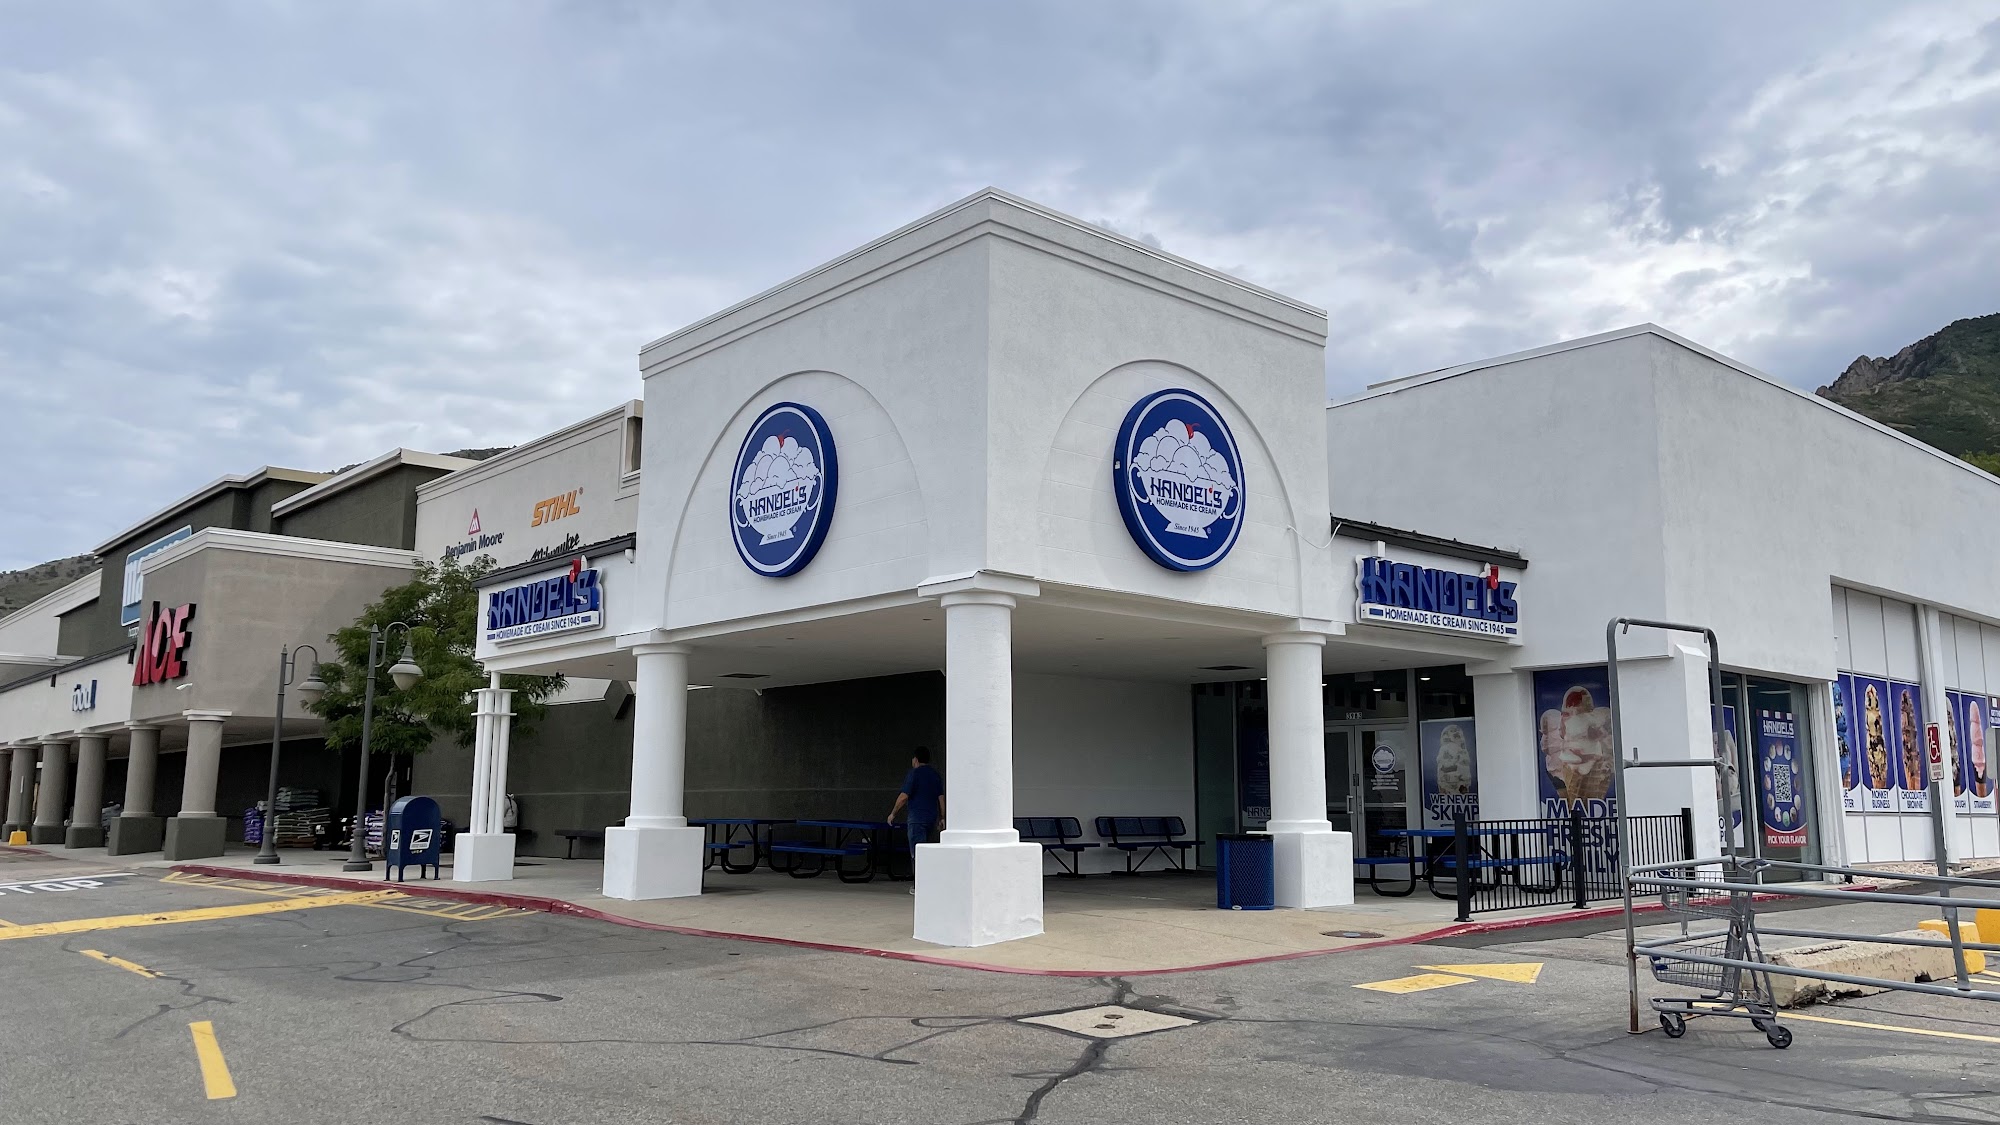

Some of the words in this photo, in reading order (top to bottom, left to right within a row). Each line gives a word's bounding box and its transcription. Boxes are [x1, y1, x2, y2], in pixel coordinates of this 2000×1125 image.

[748, 485, 807, 518] HANDEL'S
[1150, 476, 1223, 509] HANDEL'S
[531, 489, 580, 528] STIHL
[753, 511, 779, 524] HOMEMADE
[786, 505, 802, 516] CREAM
[1156, 497, 1189, 511] HOMEMADE
[1189, 504, 1198, 512] ICE
[1198, 506, 1217, 516] CREAM
[1174, 523, 1187, 532] Since
[1188, 525, 1200, 534] 1945
[445, 538, 477, 560] Benjamin
[479, 532, 503, 550] Moore
[486, 567, 598, 631] HANDEL'S
[1362, 556, 1518, 624] HANDEL'S
[496, 626, 524, 640] HOMEMADE
[524, 625, 532, 635] ICE
[532, 622, 551, 634] CREAM
[551, 619, 567, 631] SINCE
[567, 616, 581, 628] 1945
[1385, 608, 1428, 624] HOMEMADE
[1430, 614, 1441, 626] ICE
[1442, 616, 1467, 630] CREAM
[1468, 620, 1488, 633] SINCE
[1489, 623, 1505, 635] 1945
[132, 600, 197, 688] ACE
[1430, 794, 1446, 805] WE
[1447, 794, 1479, 805] NEVER
[1871, 790, 1889, 799] MONKEY
[1247, 807, 1271, 817] HAND
[1431, 804, 1480, 821] SKIMP
[1546, 799, 1618, 821] MADE
[1872, 800, 1891, 809] BUSINESS
[1907, 800, 1924, 809] BROWNIE
[1768, 835, 1778, 845] PICK
[1778, 835, 1790, 845] YOUR
[1790, 835, 1807, 845] FLAVOR
[0, 880, 105, 896] TOP
